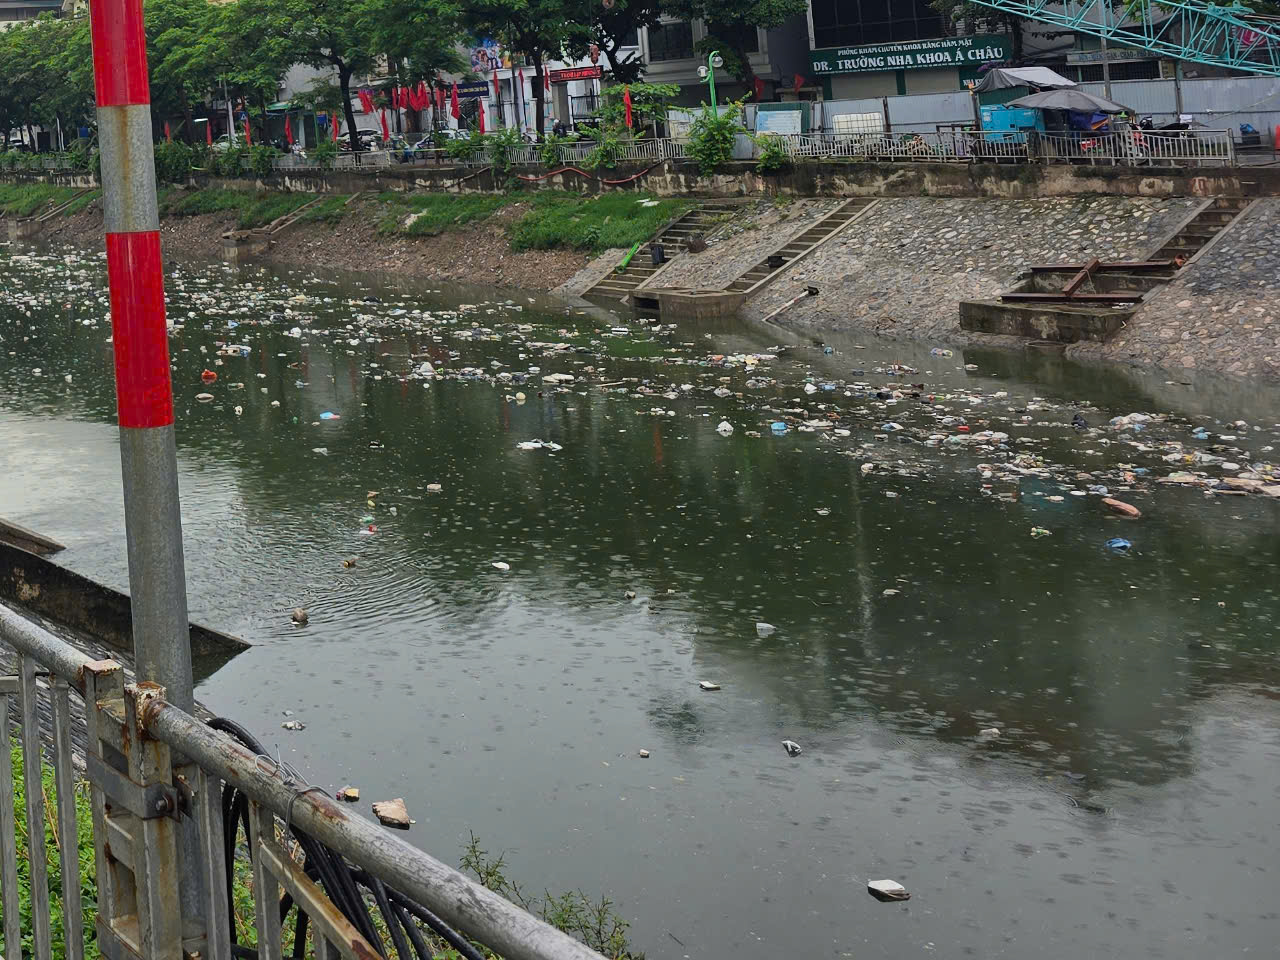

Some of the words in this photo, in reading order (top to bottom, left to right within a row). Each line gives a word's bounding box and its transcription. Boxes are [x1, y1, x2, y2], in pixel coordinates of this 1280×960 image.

[813, 61, 833, 72] DR.
[836, 54, 884, 70] TRƯỜNG
[887, 54, 913, 67] NHA
[917, 51, 952, 64] KHOA
[955, 47, 964, 61] Á
[967, 47, 1004, 61] CHÂU
